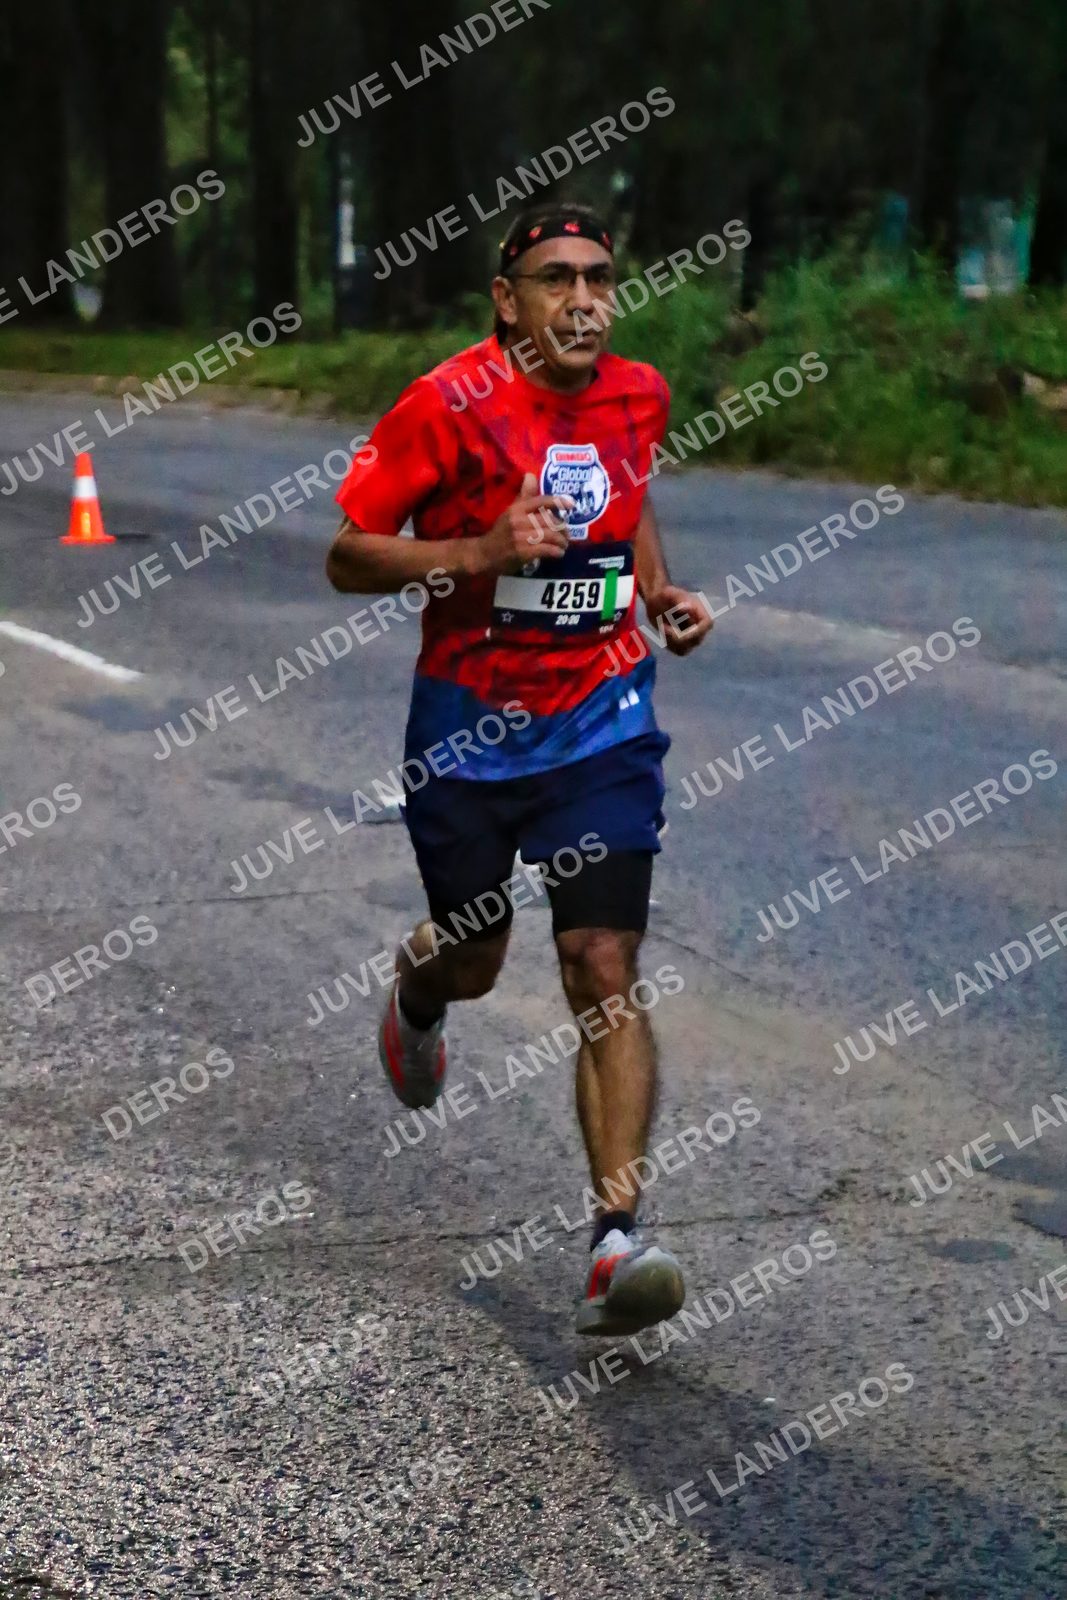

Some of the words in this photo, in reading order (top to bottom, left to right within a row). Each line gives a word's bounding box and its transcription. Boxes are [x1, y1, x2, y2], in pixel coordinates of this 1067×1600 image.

[558, 467, 593, 481] Global
[552, 480, 580, 494] Race
[541, 582, 600, 609] 4259
